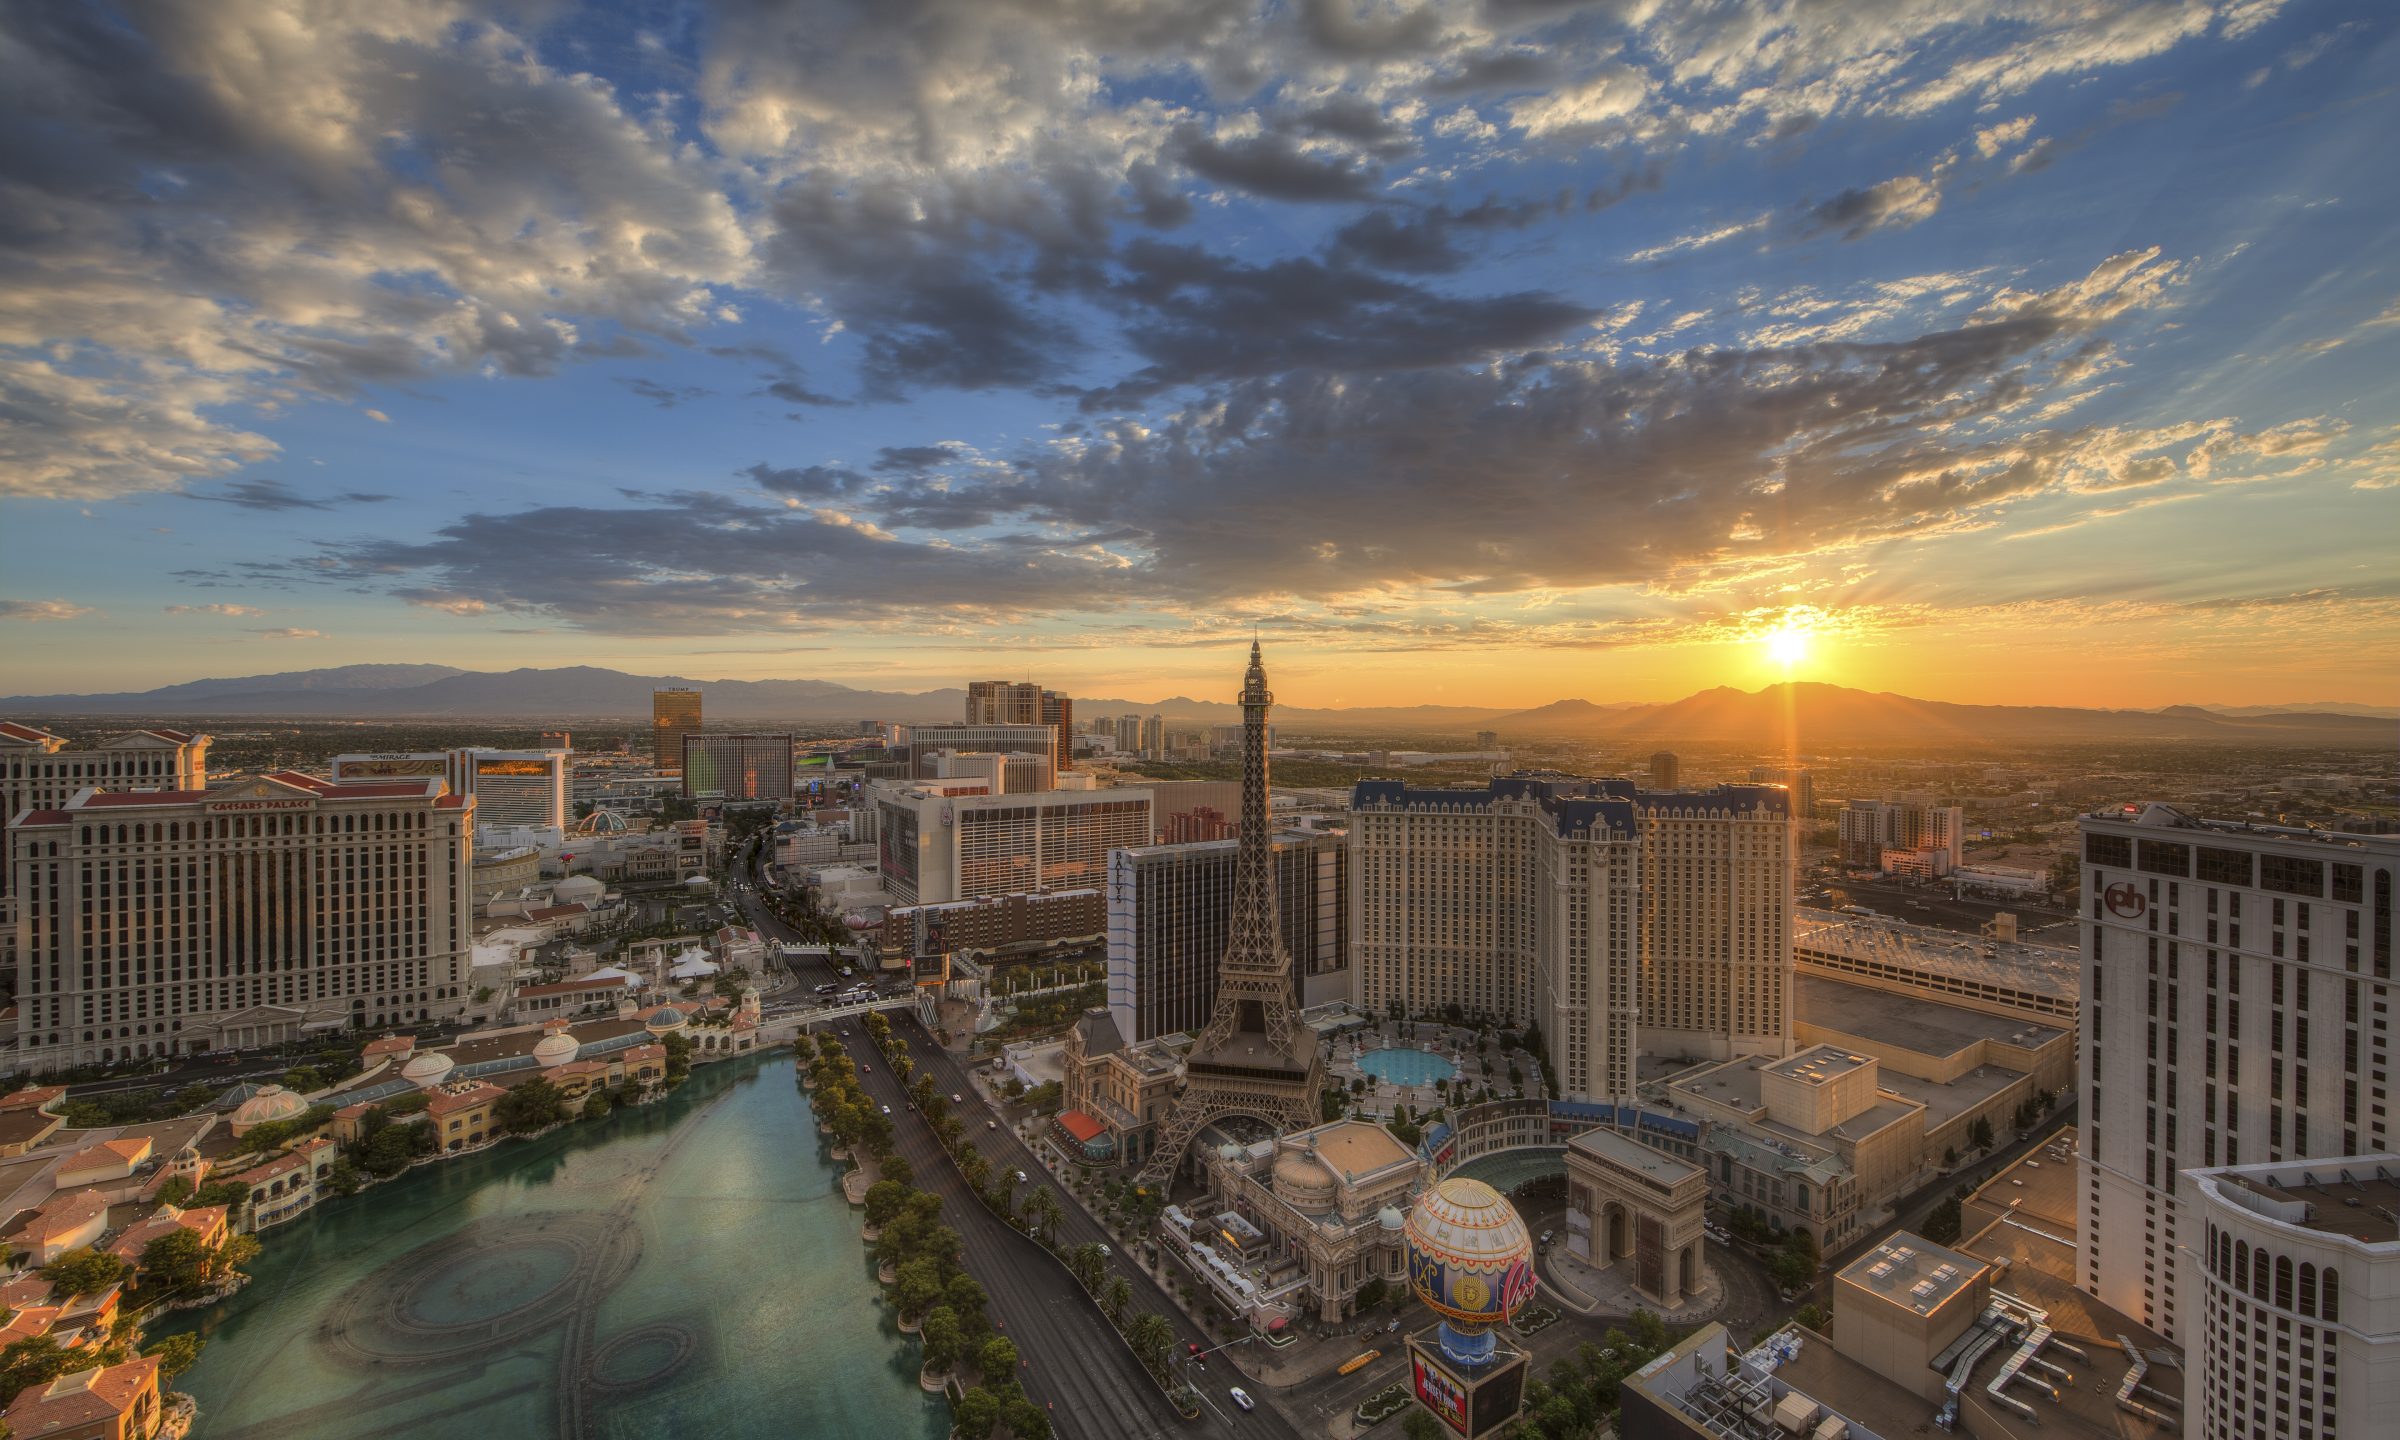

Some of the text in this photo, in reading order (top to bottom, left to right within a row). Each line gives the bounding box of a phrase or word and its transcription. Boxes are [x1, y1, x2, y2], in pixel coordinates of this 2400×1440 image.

[211, 800, 310, 811] CAESARS PALACE
[2109, 883, 2146, 912] ph
[1502, 1258, 1538, 1327] Paris
